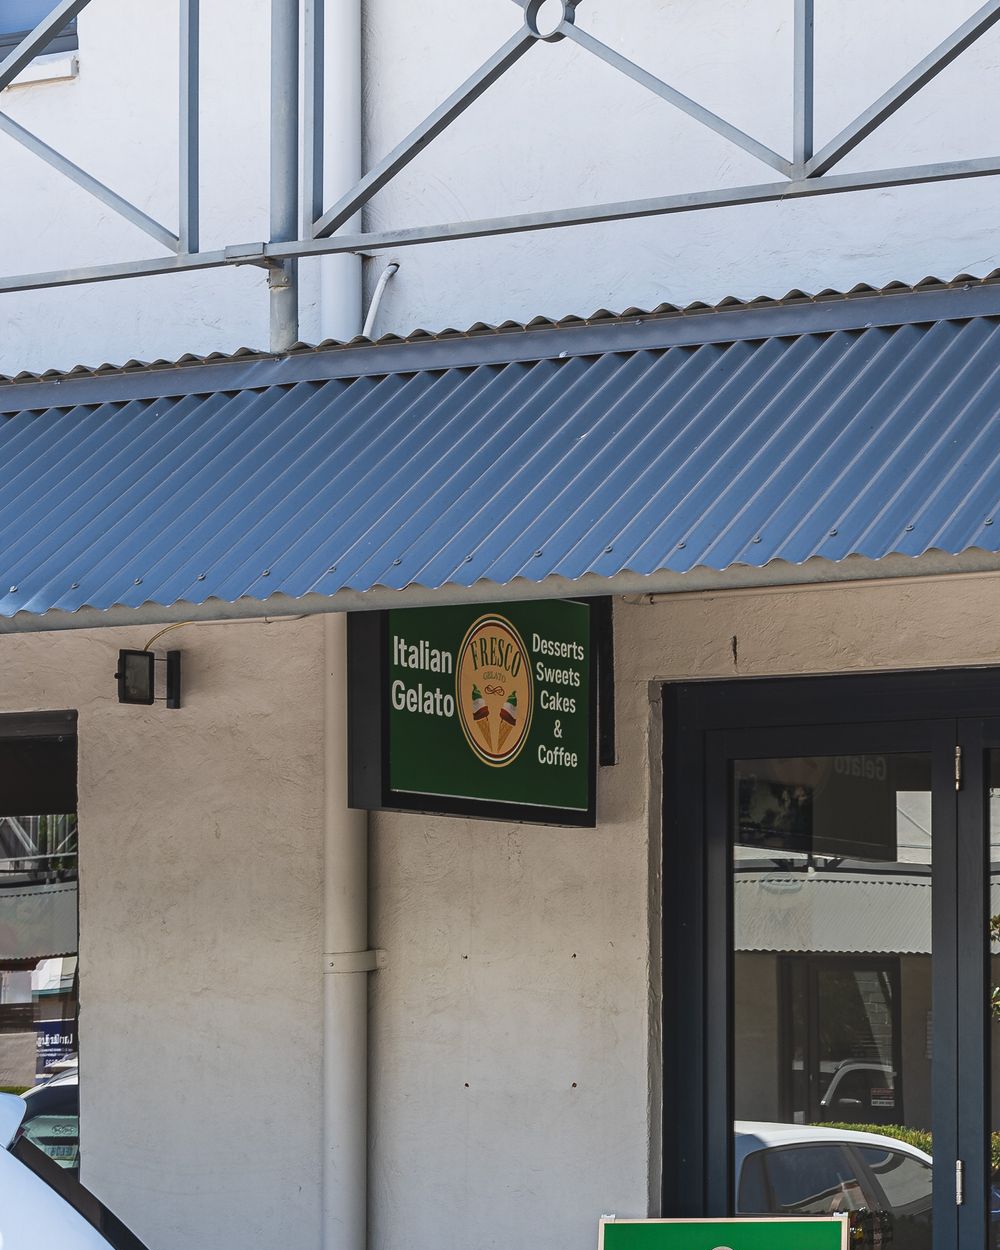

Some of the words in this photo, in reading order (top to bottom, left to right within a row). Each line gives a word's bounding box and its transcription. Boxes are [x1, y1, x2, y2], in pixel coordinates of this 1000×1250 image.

[393, 636, 452, 674] Italian
[470, 636, 521, 678] FRESCO
[532, 633, 584, 661] Desserts
[536, 662, 580, 687] Sweets
[391, 679, 455, 718] Gelato
[540, 690, 576, 714] Cakes
[553, 720, 563, 738] &
[538, 745, 578, 767] Coffee
